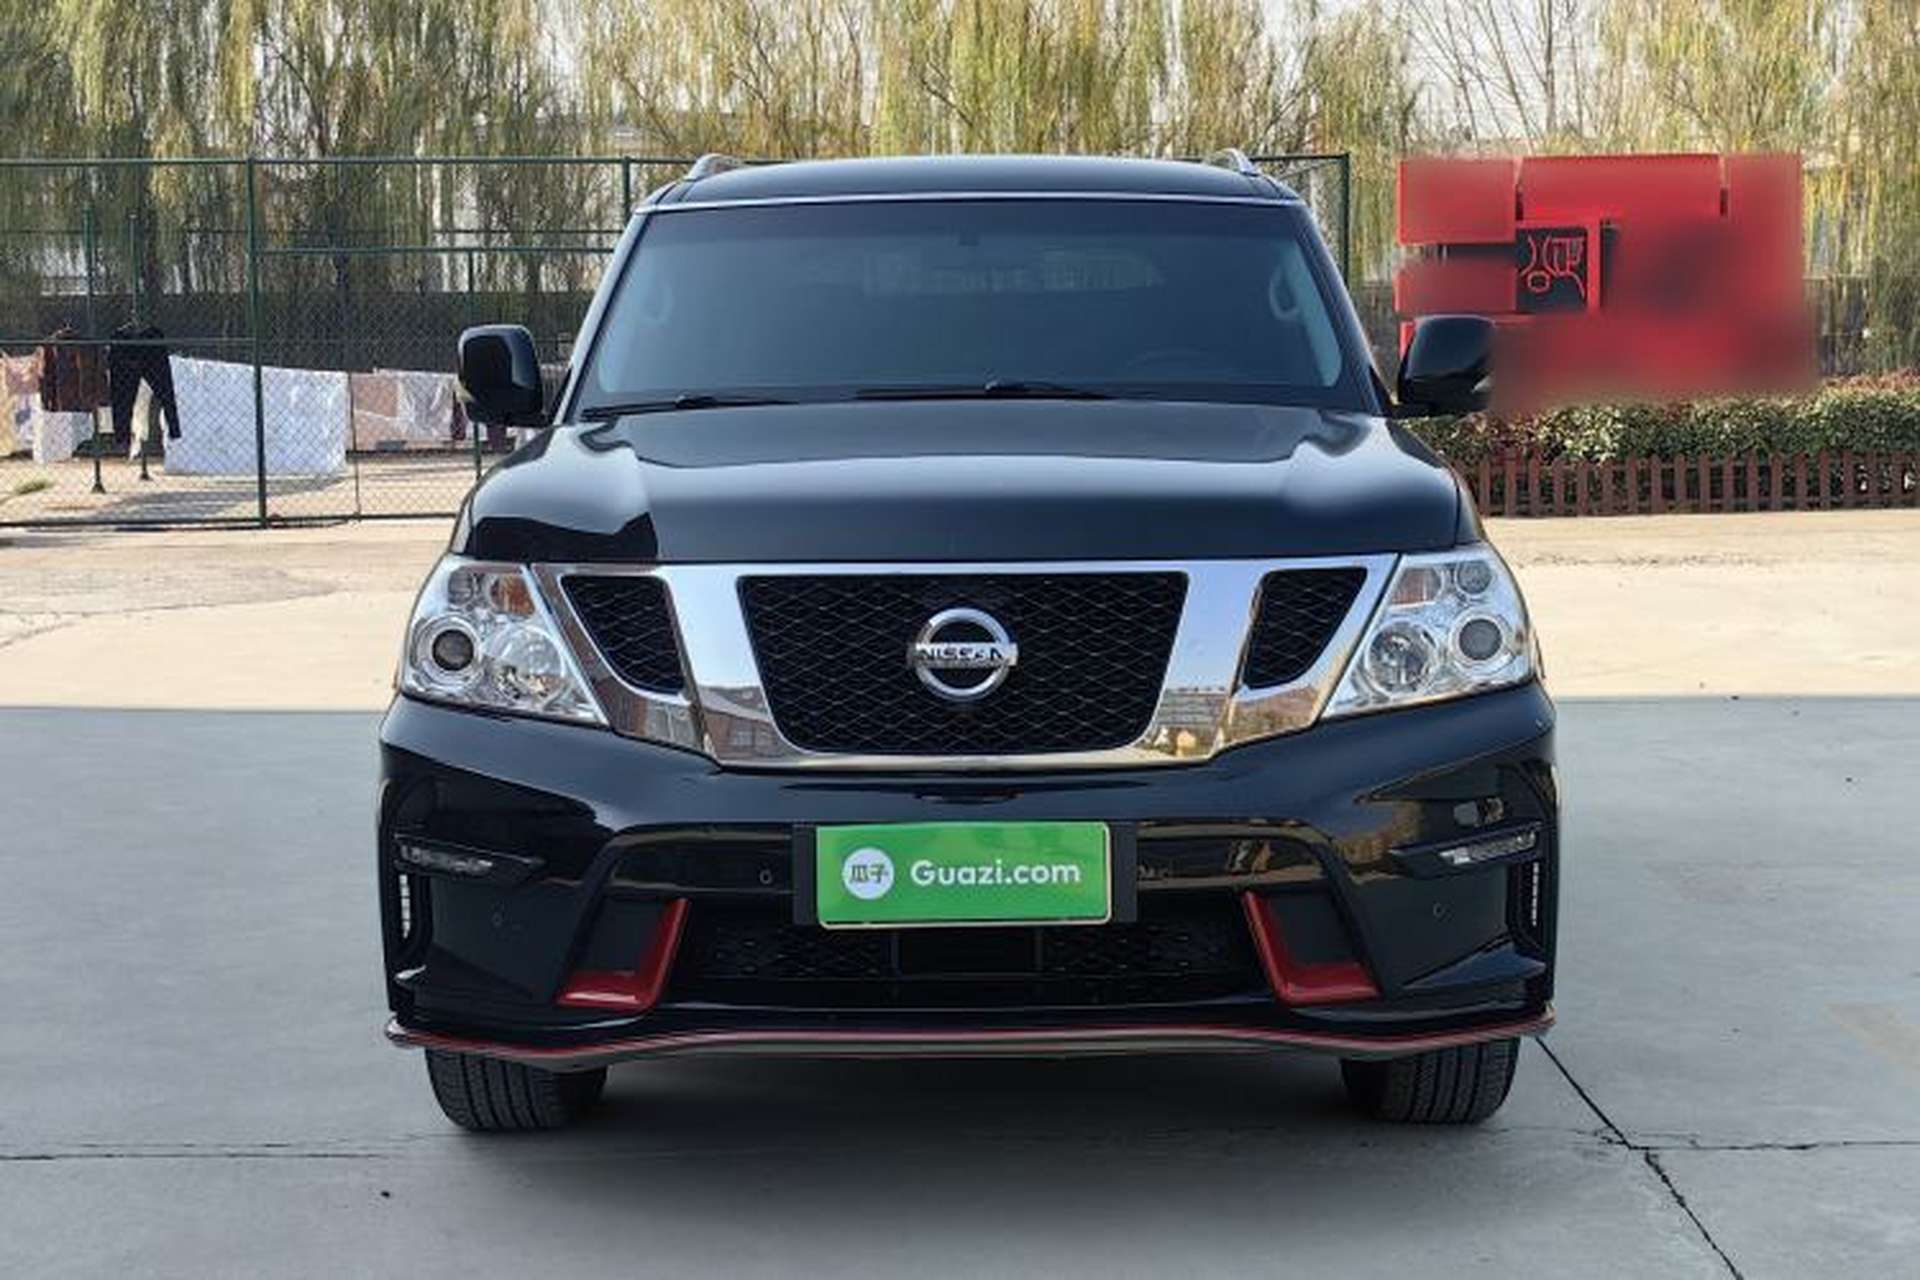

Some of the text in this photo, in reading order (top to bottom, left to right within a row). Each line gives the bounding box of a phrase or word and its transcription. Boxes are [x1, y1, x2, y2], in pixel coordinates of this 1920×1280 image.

[911, 643, 1012, 664] NISSAN
[850, 864, 888, 884] 瓜子
[910, 859, 1081, 886] Guazi.com
